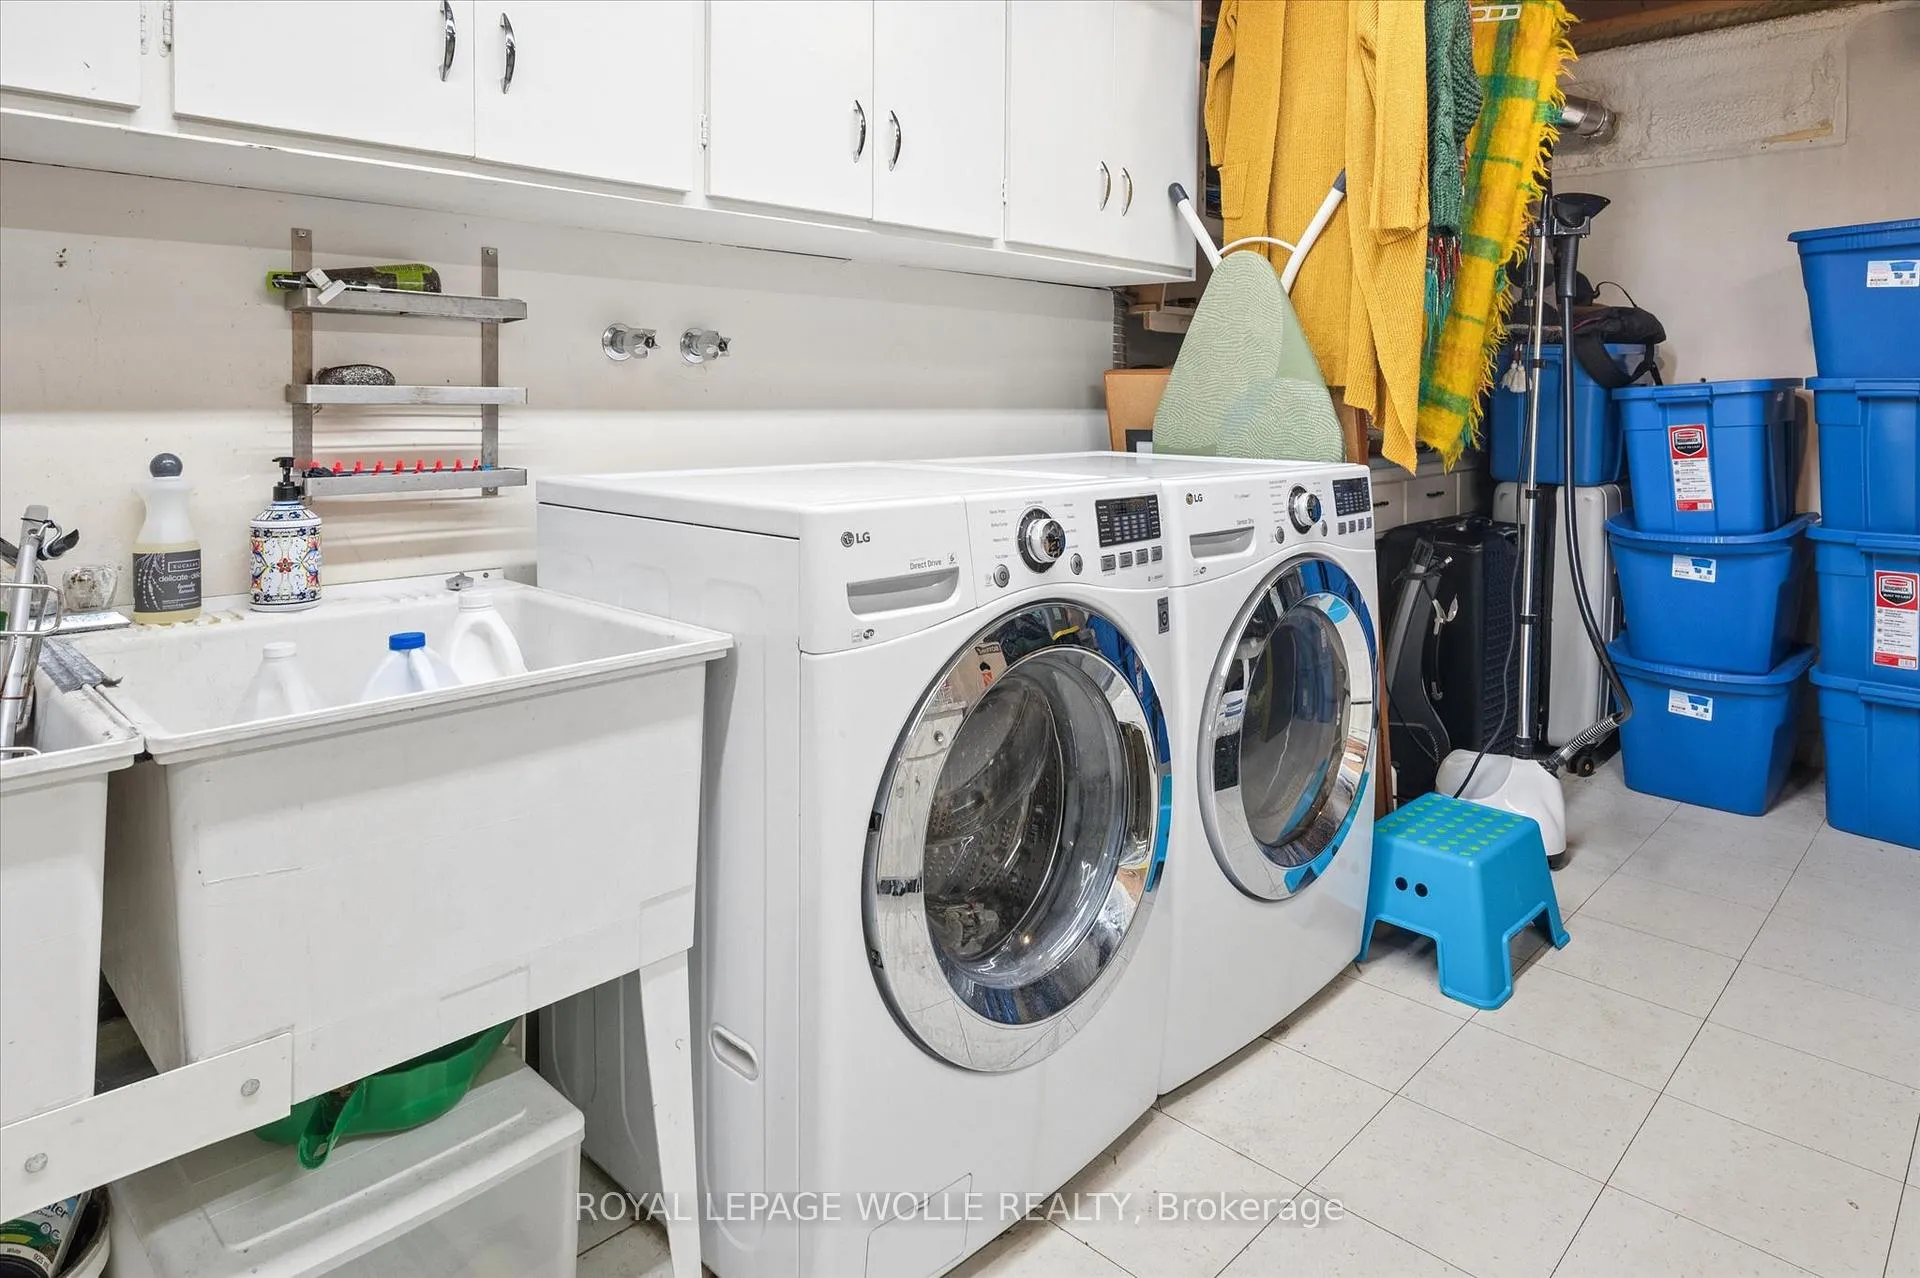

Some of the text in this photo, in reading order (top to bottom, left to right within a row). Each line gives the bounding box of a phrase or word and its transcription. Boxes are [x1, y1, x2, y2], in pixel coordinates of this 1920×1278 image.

[1194, 493, 1203, 503] LG
[856, 532, 871, 544] LG
[909, 559, 942, 570] Direct Drive
